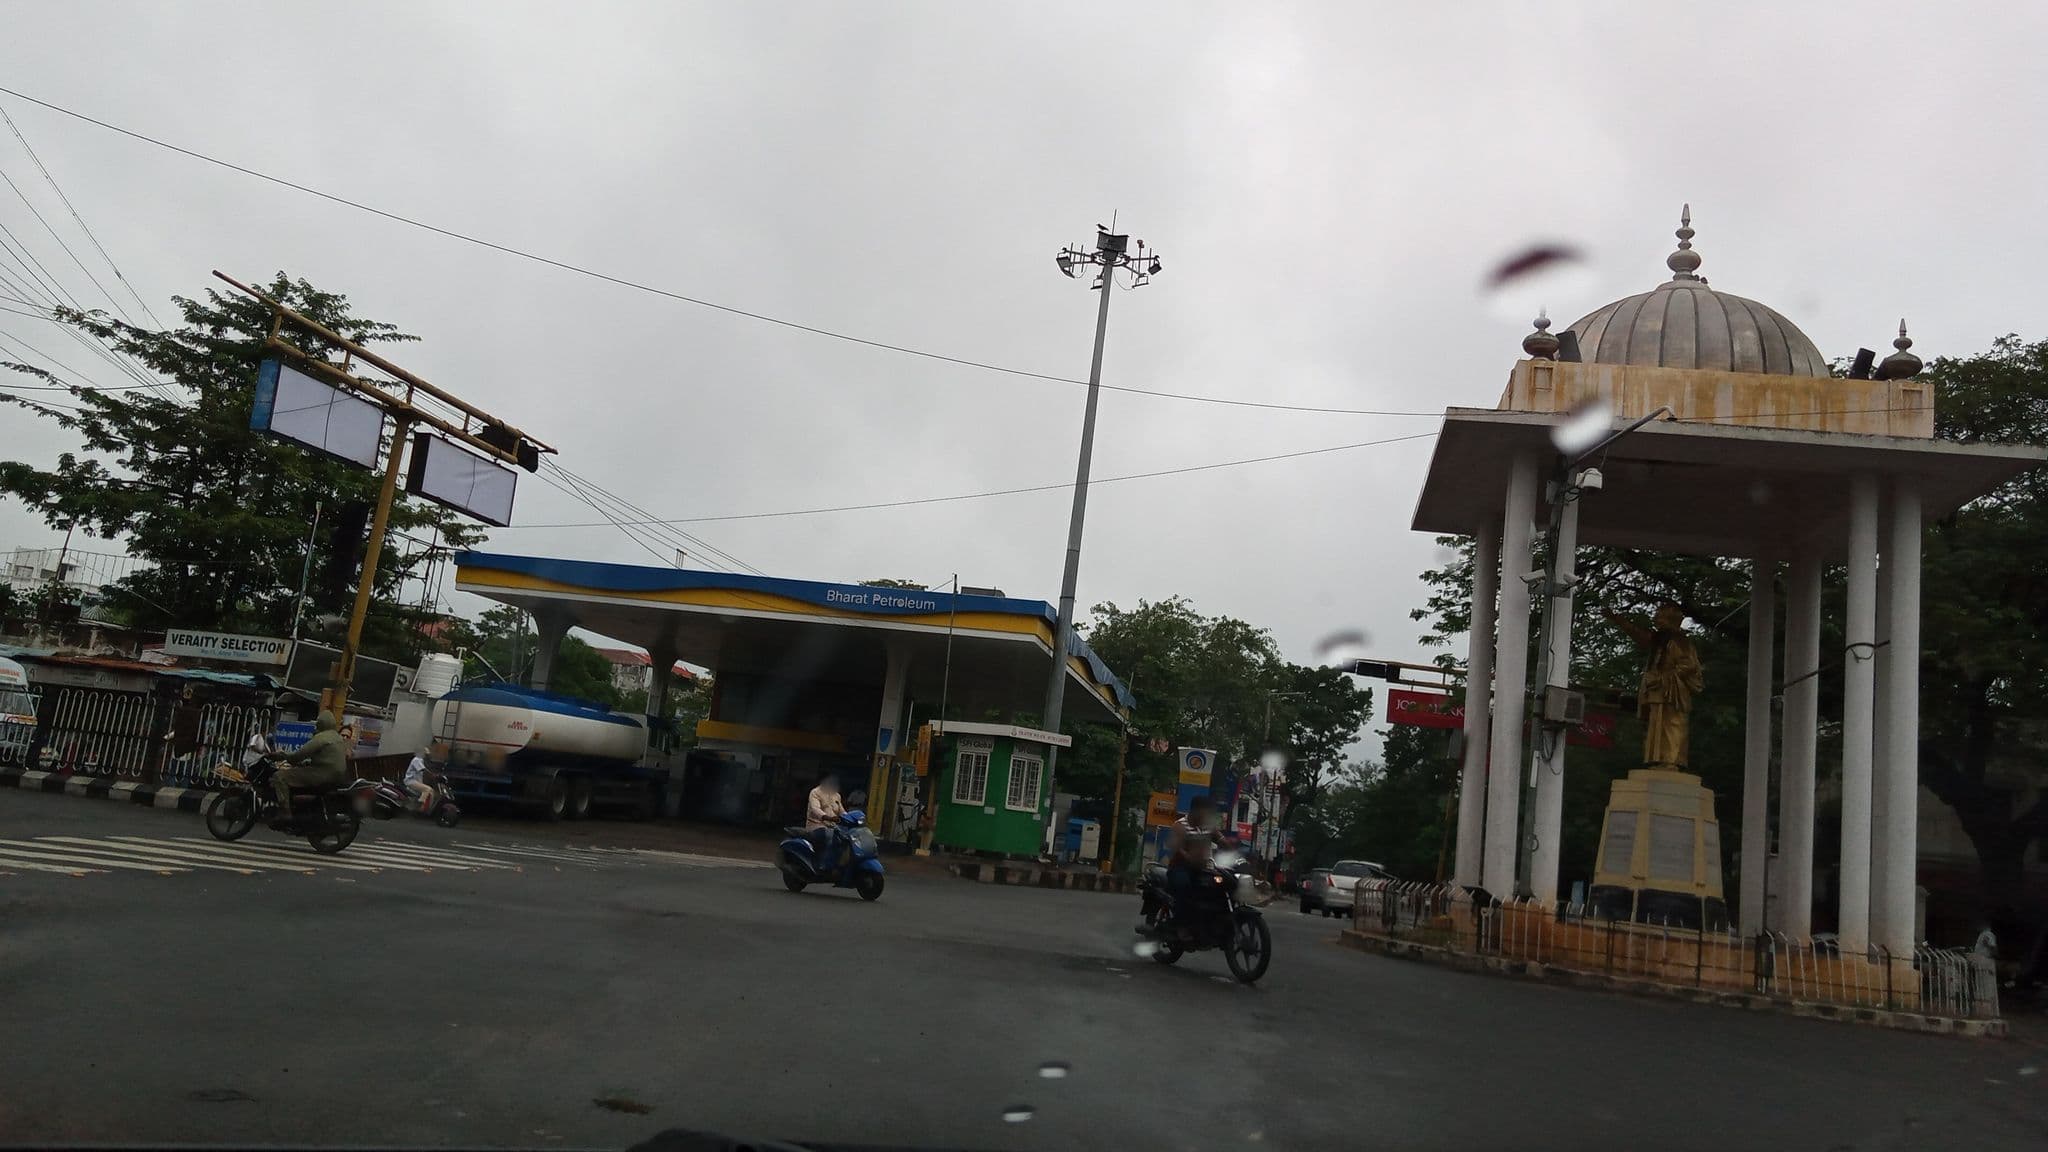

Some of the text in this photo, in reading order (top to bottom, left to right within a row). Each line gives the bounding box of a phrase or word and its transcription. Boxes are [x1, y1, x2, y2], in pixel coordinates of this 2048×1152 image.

[826, 589, 936, 611] Bharat Petroleum
[171, 633, 219, 648] VERAITY
[220, 638, 286, 655] SELECTION
